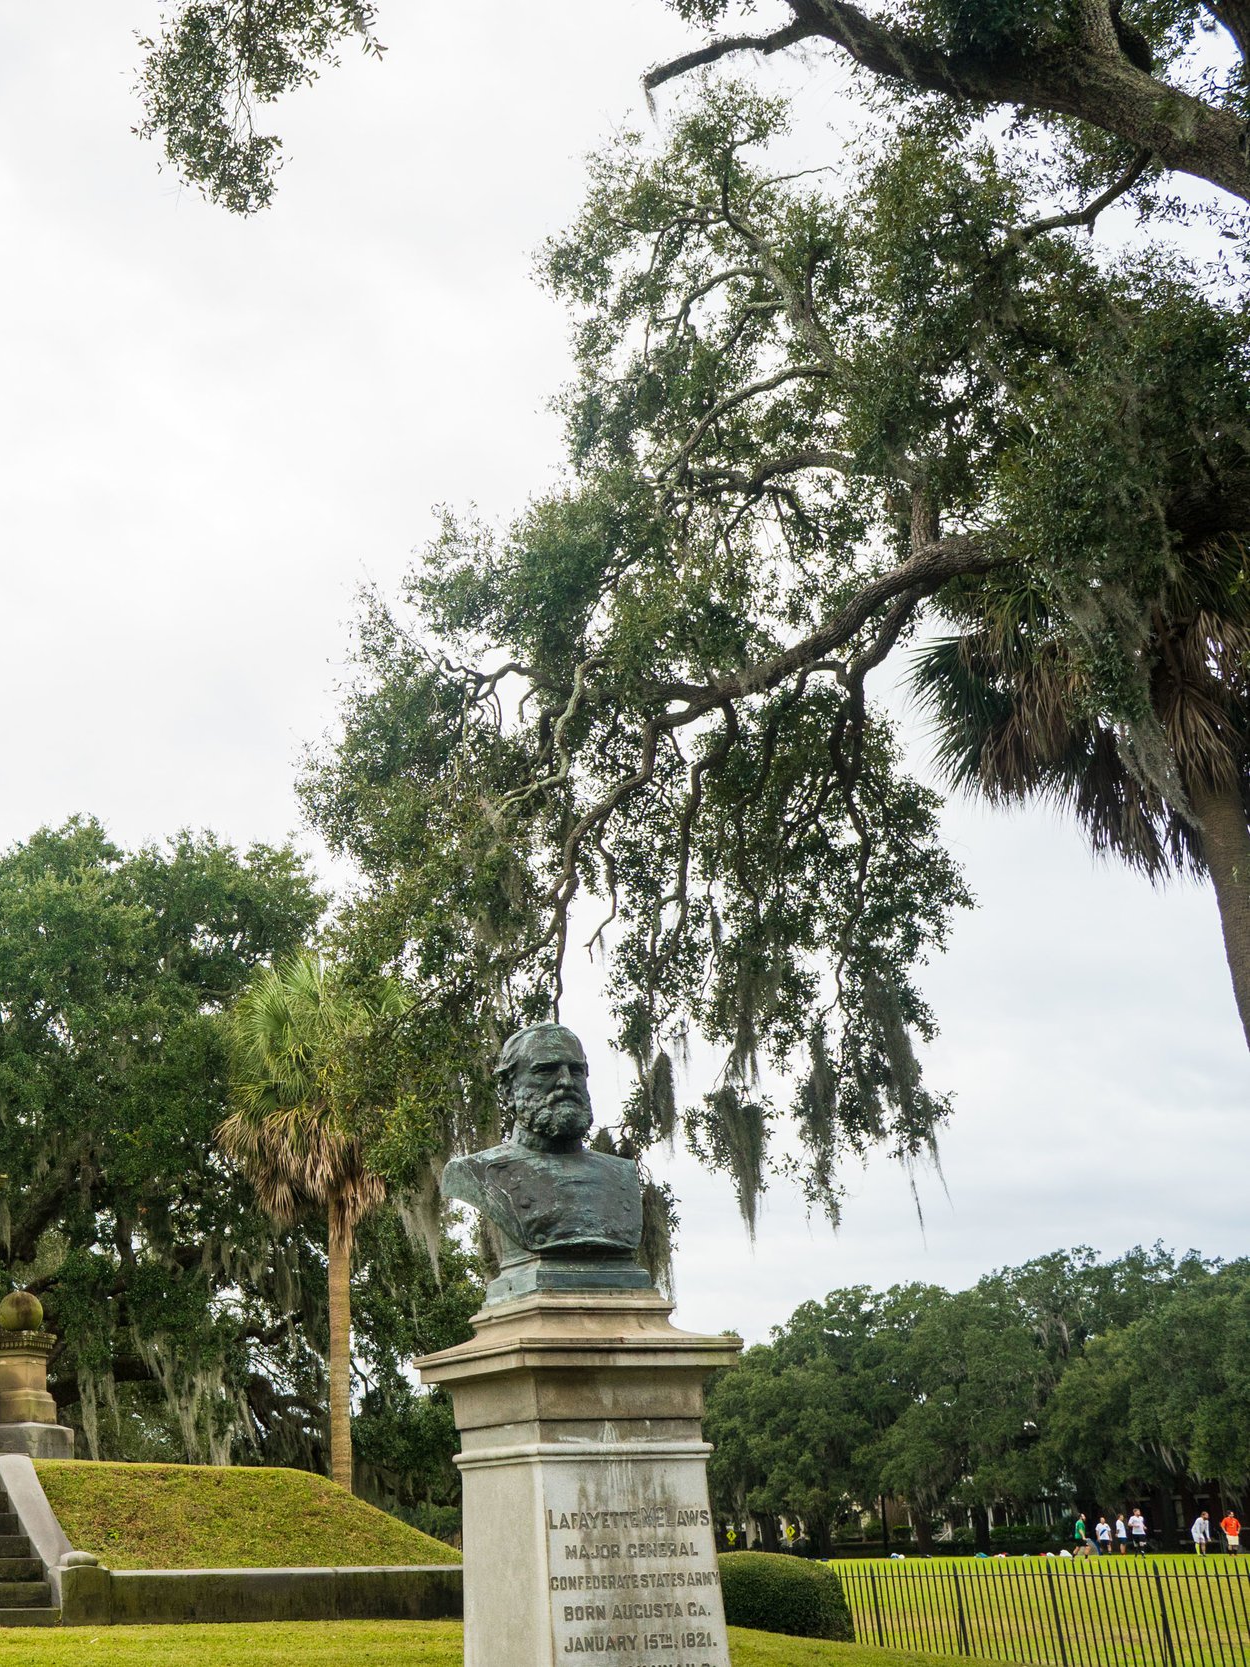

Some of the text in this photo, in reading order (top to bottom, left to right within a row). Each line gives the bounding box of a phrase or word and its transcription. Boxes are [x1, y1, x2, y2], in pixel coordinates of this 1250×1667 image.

[548, 1509, 639, 1530] LAFAYETTE
[565, 1542, 699, 1560] MAJOR GENERAL
[550, 1571, 719, 1591] CONFEDERATE STATES ARMY
[564, 1604, 606, 1621] BORN
[612, 1603, 684, 1620] AUGUSTA
[564, 1634, 638, 1653] JANUARY
